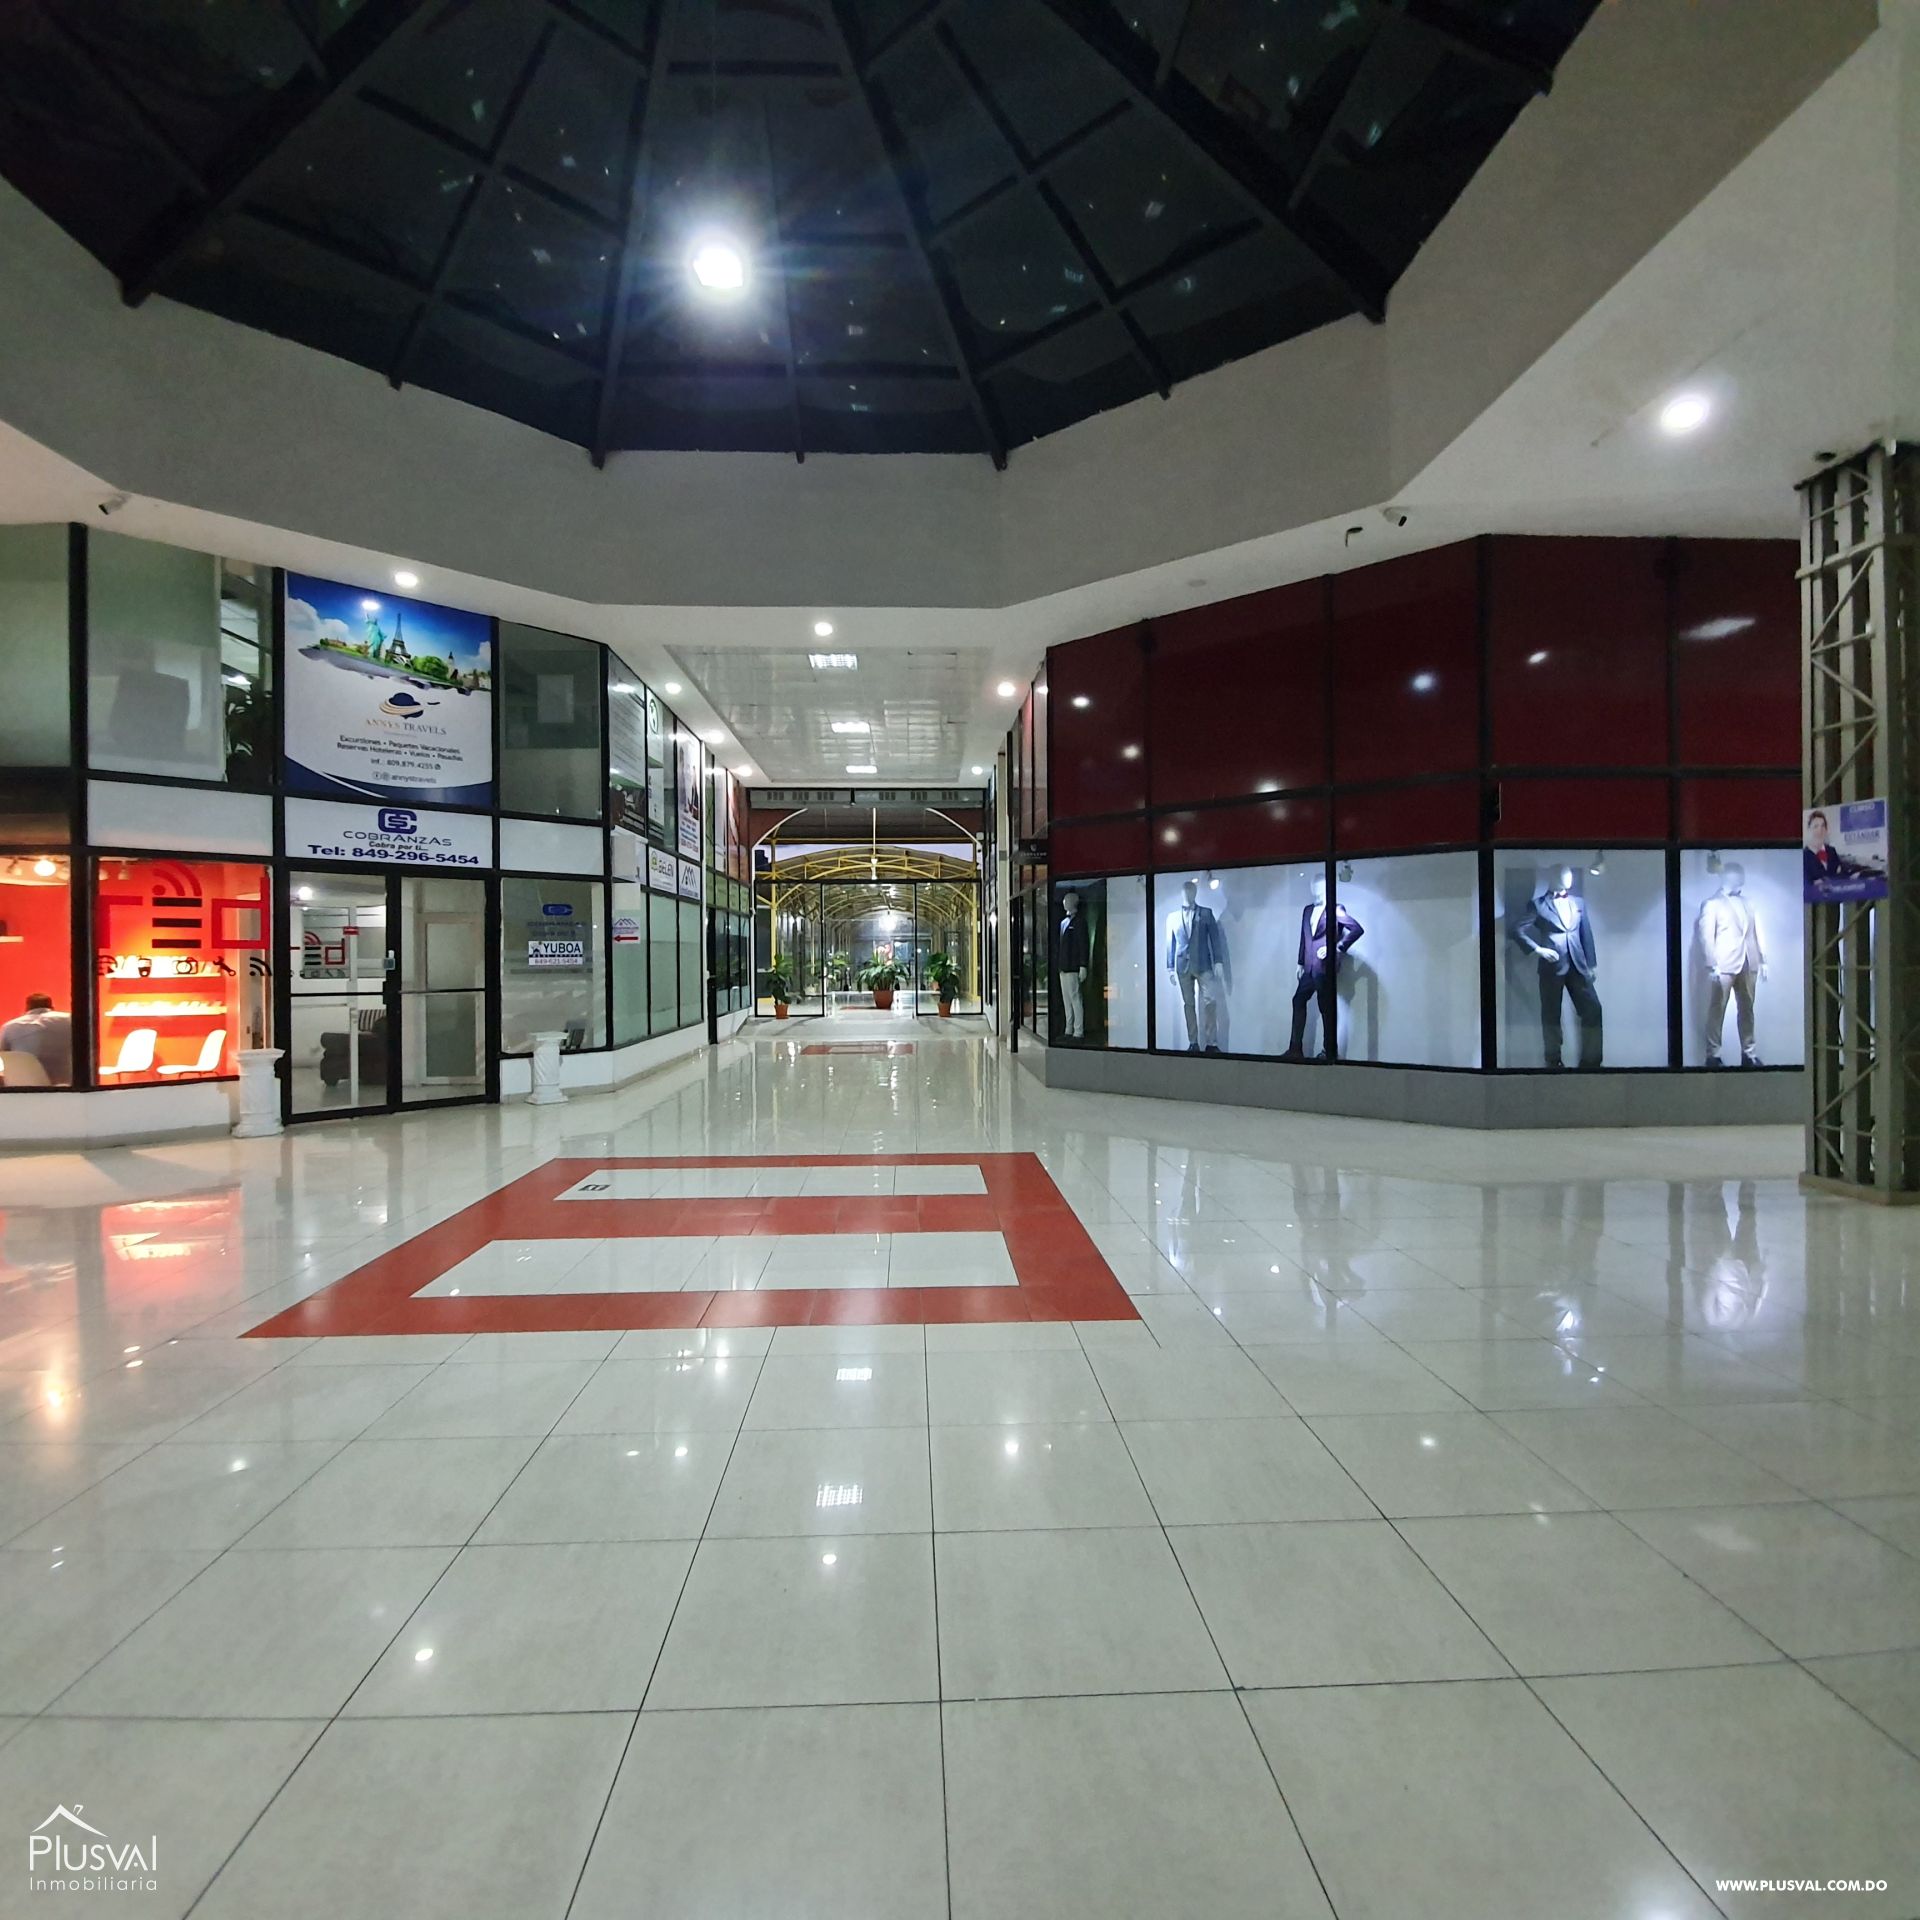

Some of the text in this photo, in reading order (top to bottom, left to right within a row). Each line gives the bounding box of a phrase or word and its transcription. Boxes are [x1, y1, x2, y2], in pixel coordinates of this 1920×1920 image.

[403, 722, 447, 735] TRAVELS
[343, 830, 452, 847] COBRANZAS
[369, 841, 396, 850] Cobra
[398, 843, 413, 852] por
[307, 844, 480, 865] Tel: 849-296-5454
[543, 942, 582, 954] YUBOA
